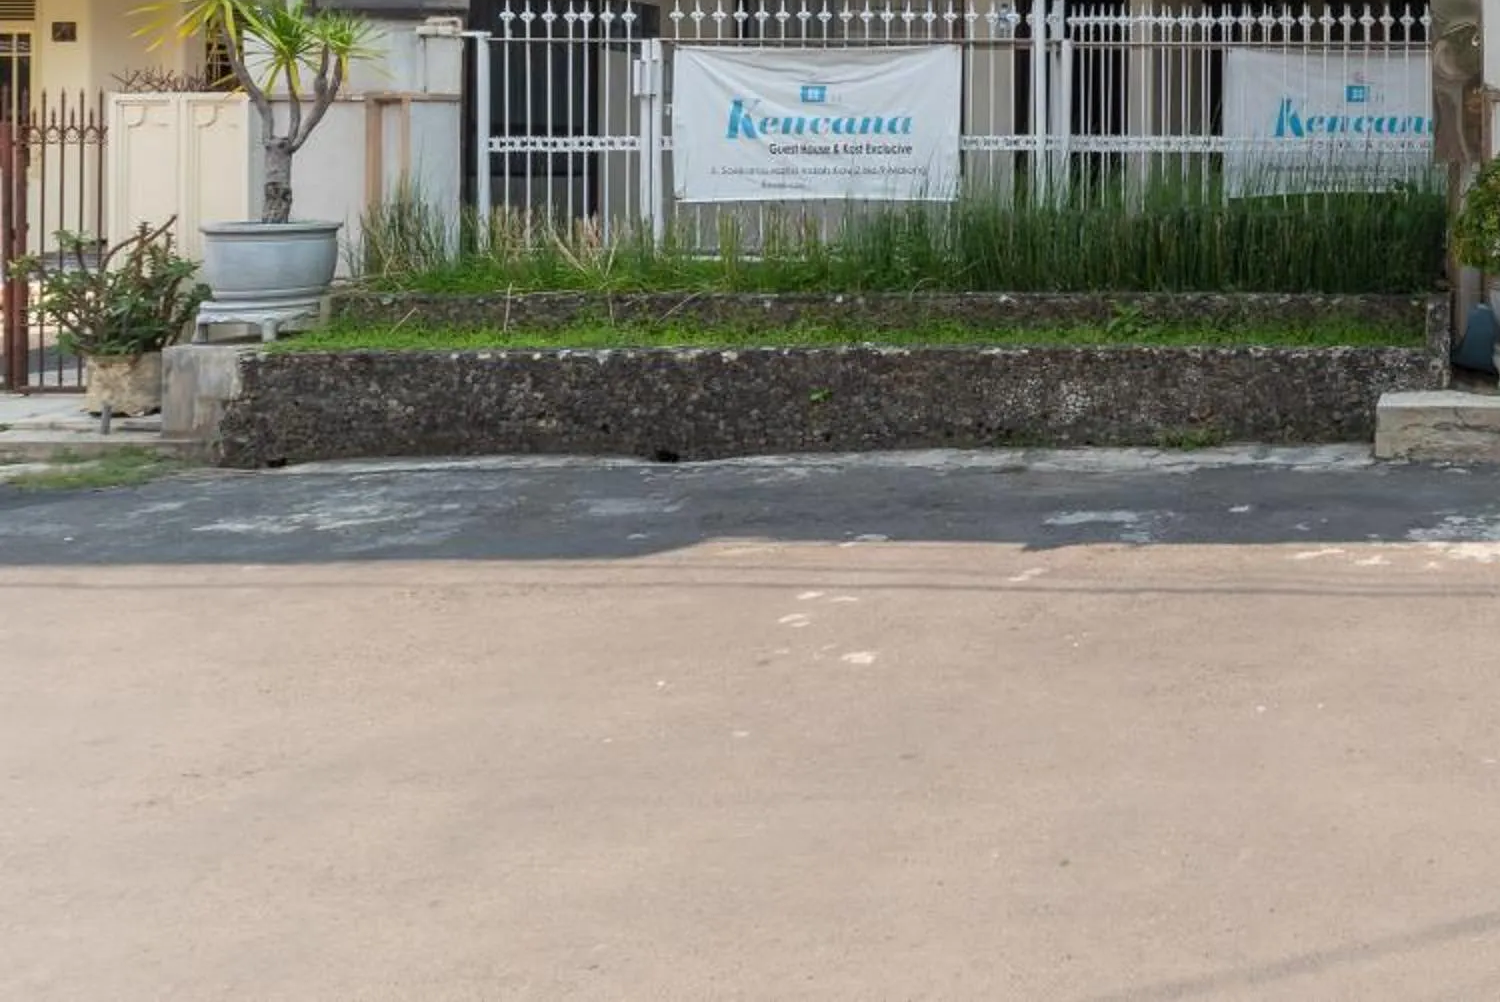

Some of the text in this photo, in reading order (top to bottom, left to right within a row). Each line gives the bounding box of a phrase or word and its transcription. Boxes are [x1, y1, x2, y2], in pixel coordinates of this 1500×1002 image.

[725, 99, 912, 139] Kencana
[1274, 98, 1433, 137] Kencan
[769, 143, 798, 155] Guest
